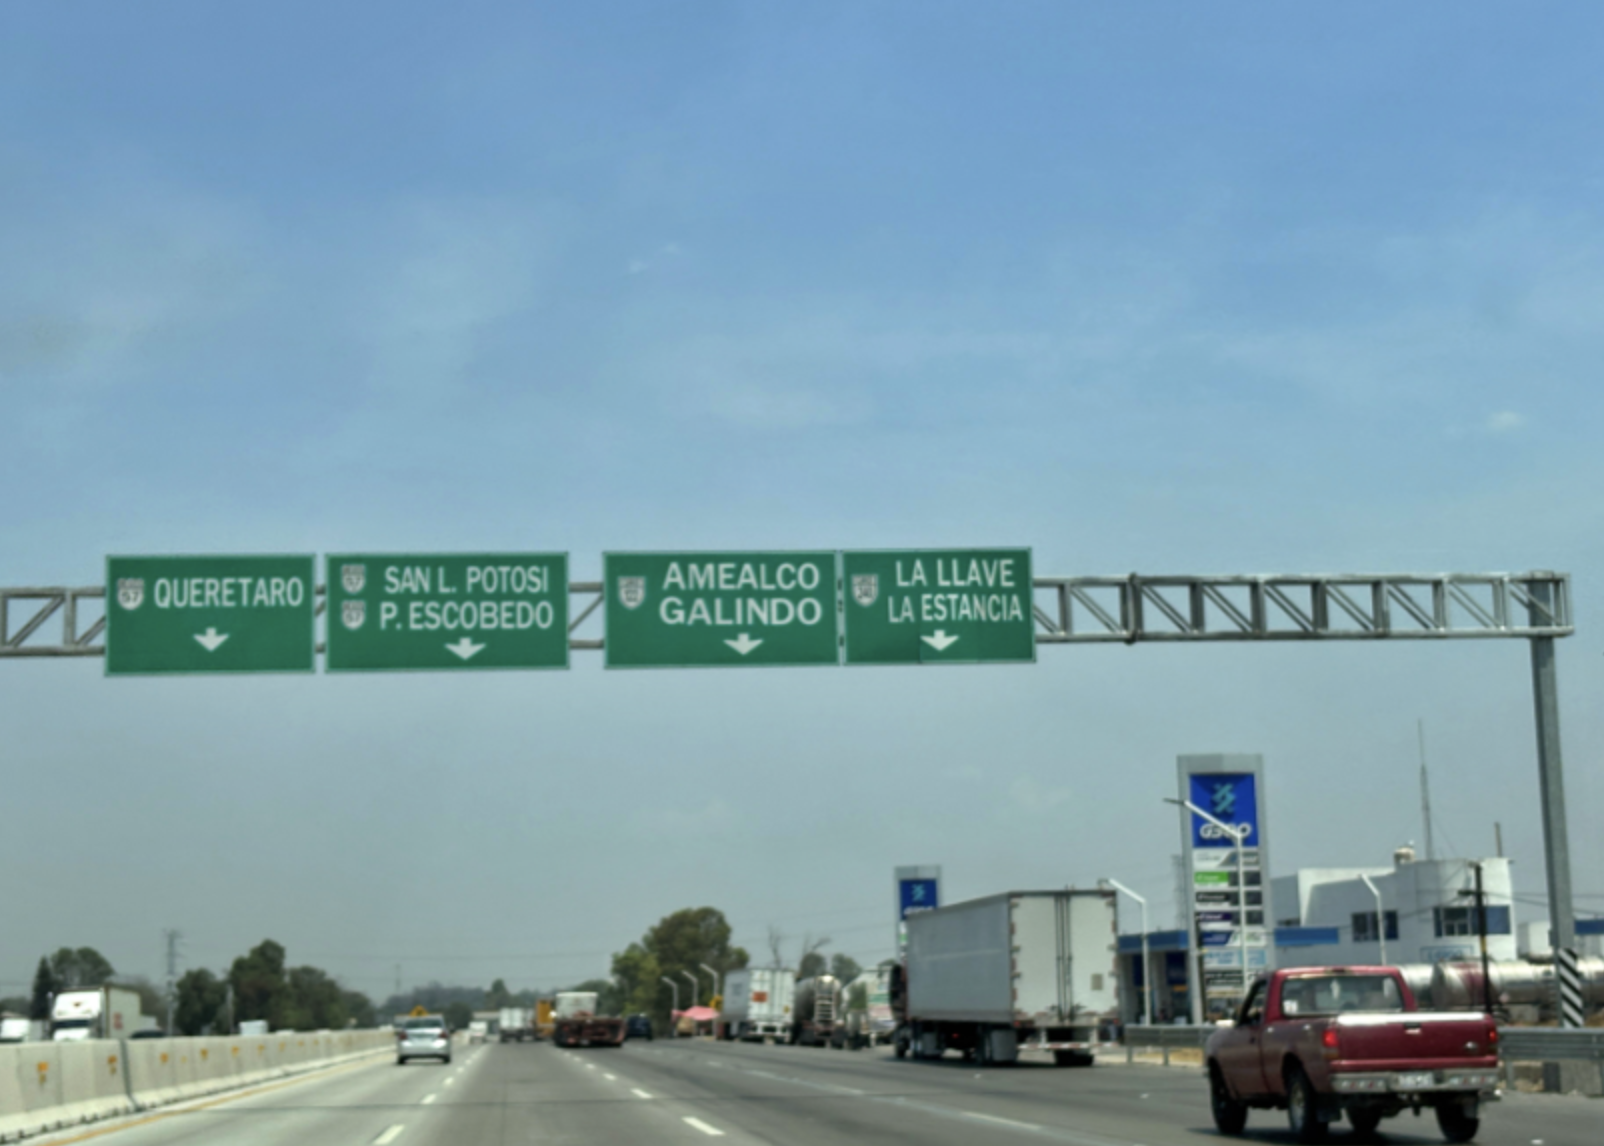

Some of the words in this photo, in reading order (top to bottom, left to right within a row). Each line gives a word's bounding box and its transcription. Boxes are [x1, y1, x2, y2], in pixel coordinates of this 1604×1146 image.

[384, 565, 431, 594] SAN
[438, 567, 457, 594] L.
[466, 565, 548, 594] POTOSI
[662, 561, 820, 591] AMEALCO
[895, 559, 928, 588] LA
[936, 558, 1015, 588] LLAVE
[153, 576, 304, 609] QUERETARO
[379, 601, 402, 630] P.
[408, 600, 554, 630] ESCOBEDO
[659, 595, 823, 629] GALINDO
[888, 595, 915, 624] LA
[921, 592, 1023, 622] ESTANCIA
